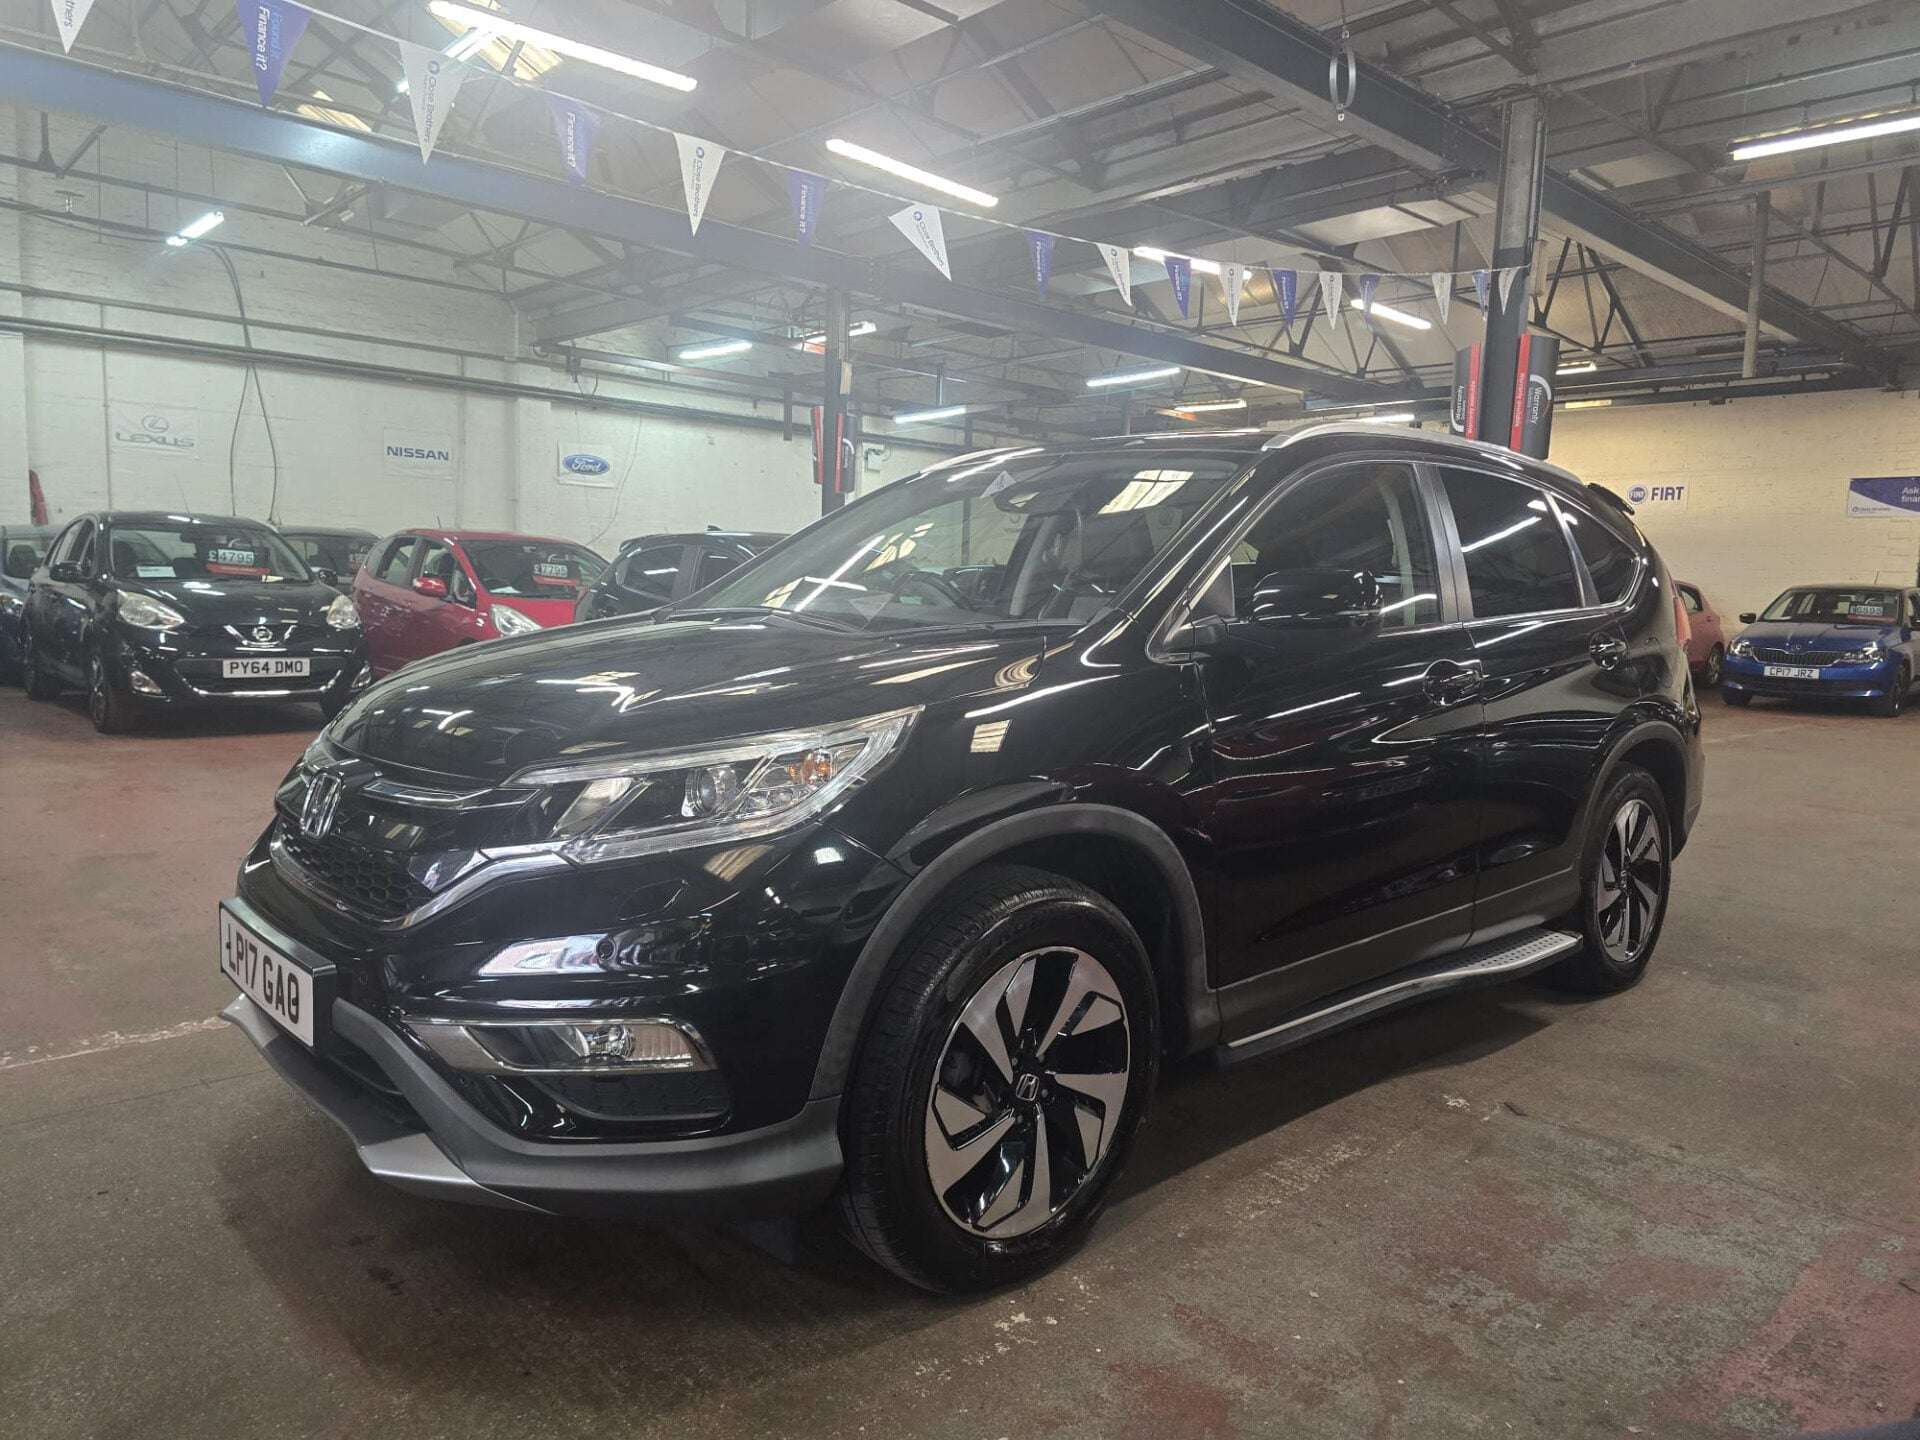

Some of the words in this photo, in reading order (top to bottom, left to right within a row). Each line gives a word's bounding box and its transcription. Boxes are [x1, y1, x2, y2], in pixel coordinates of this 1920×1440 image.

[258, 6, 270, 52] Finance
[256, 54, 267, 70] it?
[1530, 387, 1542, 424] Warranty
[115, 432, 194, 447] LEXUS
[386, 446, 449, 461] NISSAN
[571, 457, 602, 473] Ford
[1651, 486, 1684, 500] FIAT
[229, 661, 270, 675] PY64
[275, 660, 304, 673] DMO
[1769, 667, 1792, 677] CP17
[1793, 669, 1814, 678] JRZ
[227, 923, 258, 990] LP17
